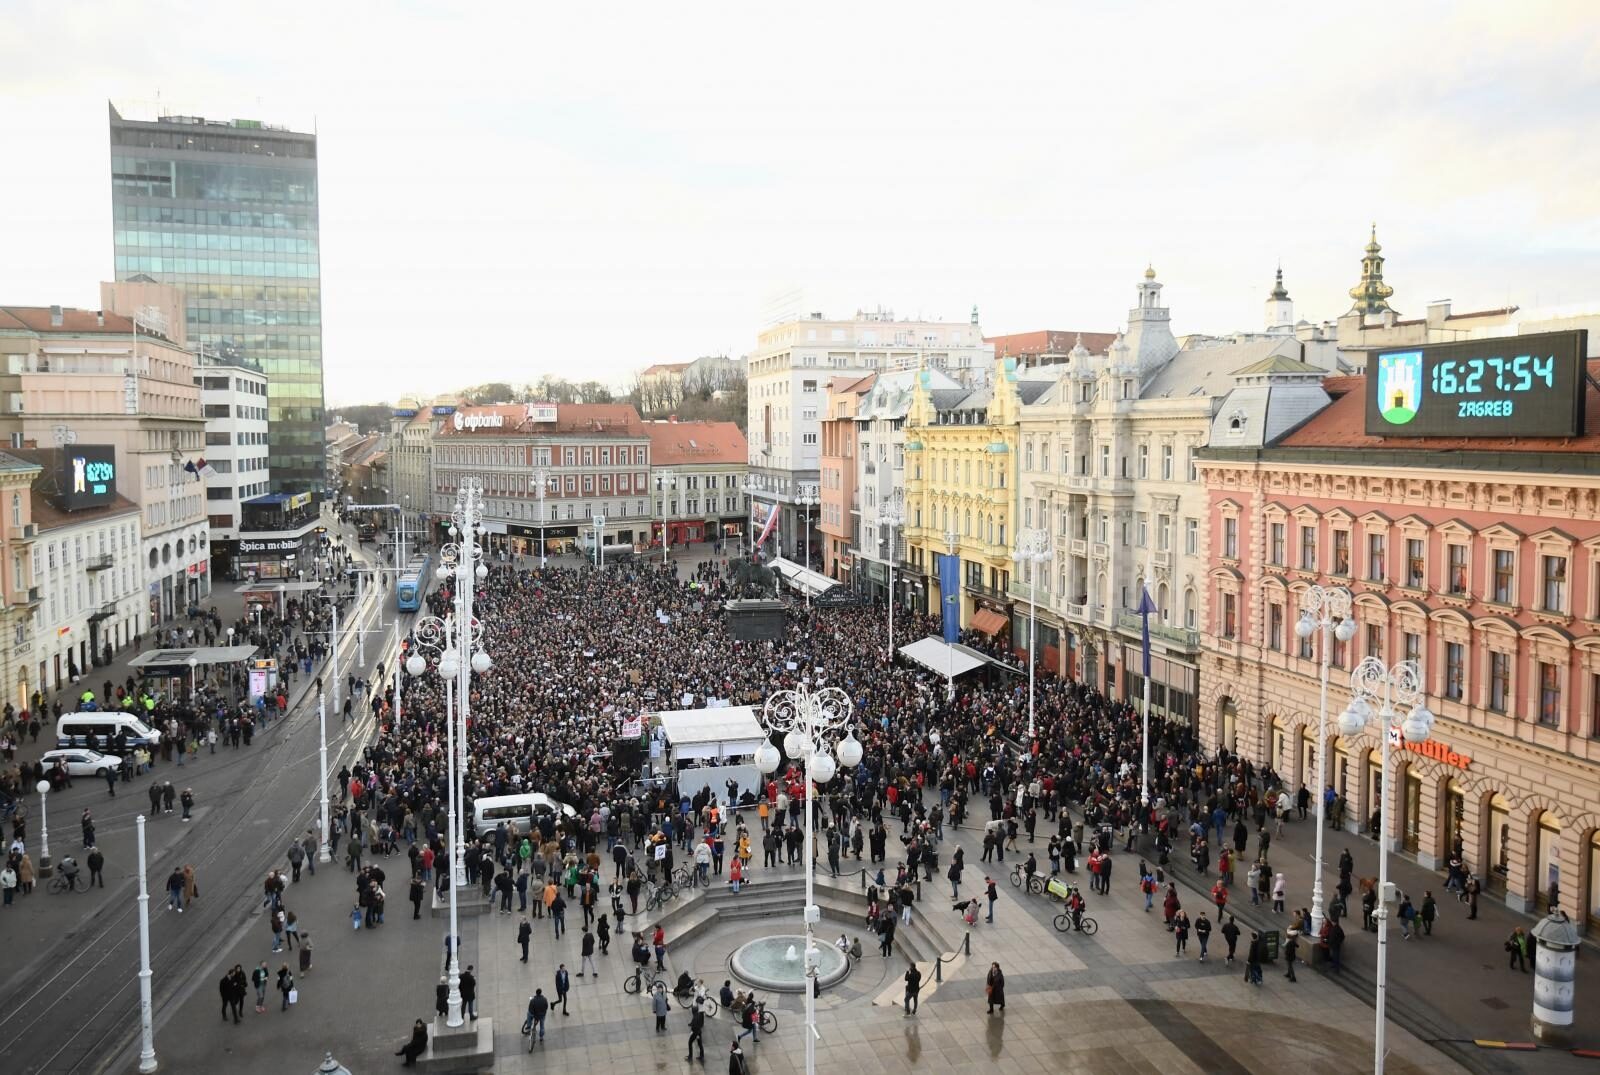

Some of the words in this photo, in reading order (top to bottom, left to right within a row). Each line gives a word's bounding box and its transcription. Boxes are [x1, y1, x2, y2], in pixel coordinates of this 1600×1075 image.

[1431, 355, 1554, 394] 16:27:54
[1458, 400, 1513, 417] ZAGREB
[240, 540, 265, 552] Špica
